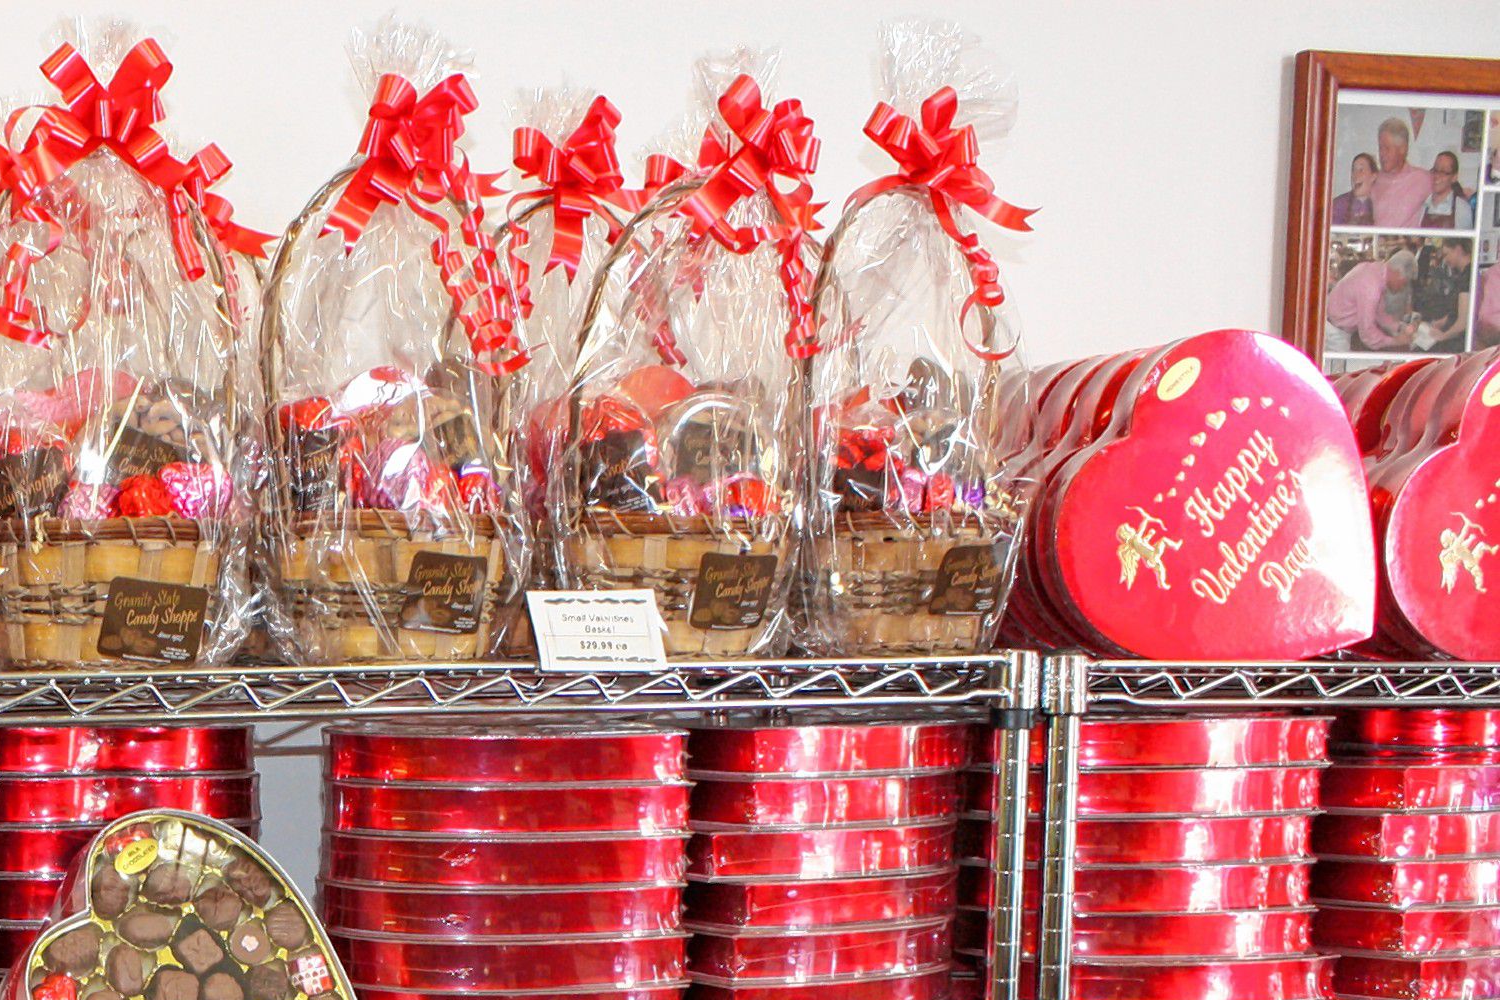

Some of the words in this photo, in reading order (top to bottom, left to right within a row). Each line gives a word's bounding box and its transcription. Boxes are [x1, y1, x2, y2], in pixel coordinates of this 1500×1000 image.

[1184, 429, 1279, 538] Happy
[1258, 535, 1317, 603] Day
[114, 591, 153, 611] Granite
[154, 589, 181, 607] State
[422, 576, 454, 605] Candy
[125, 605, 160, 635] Candy
[161, 603, 199, 632] Shoppe
